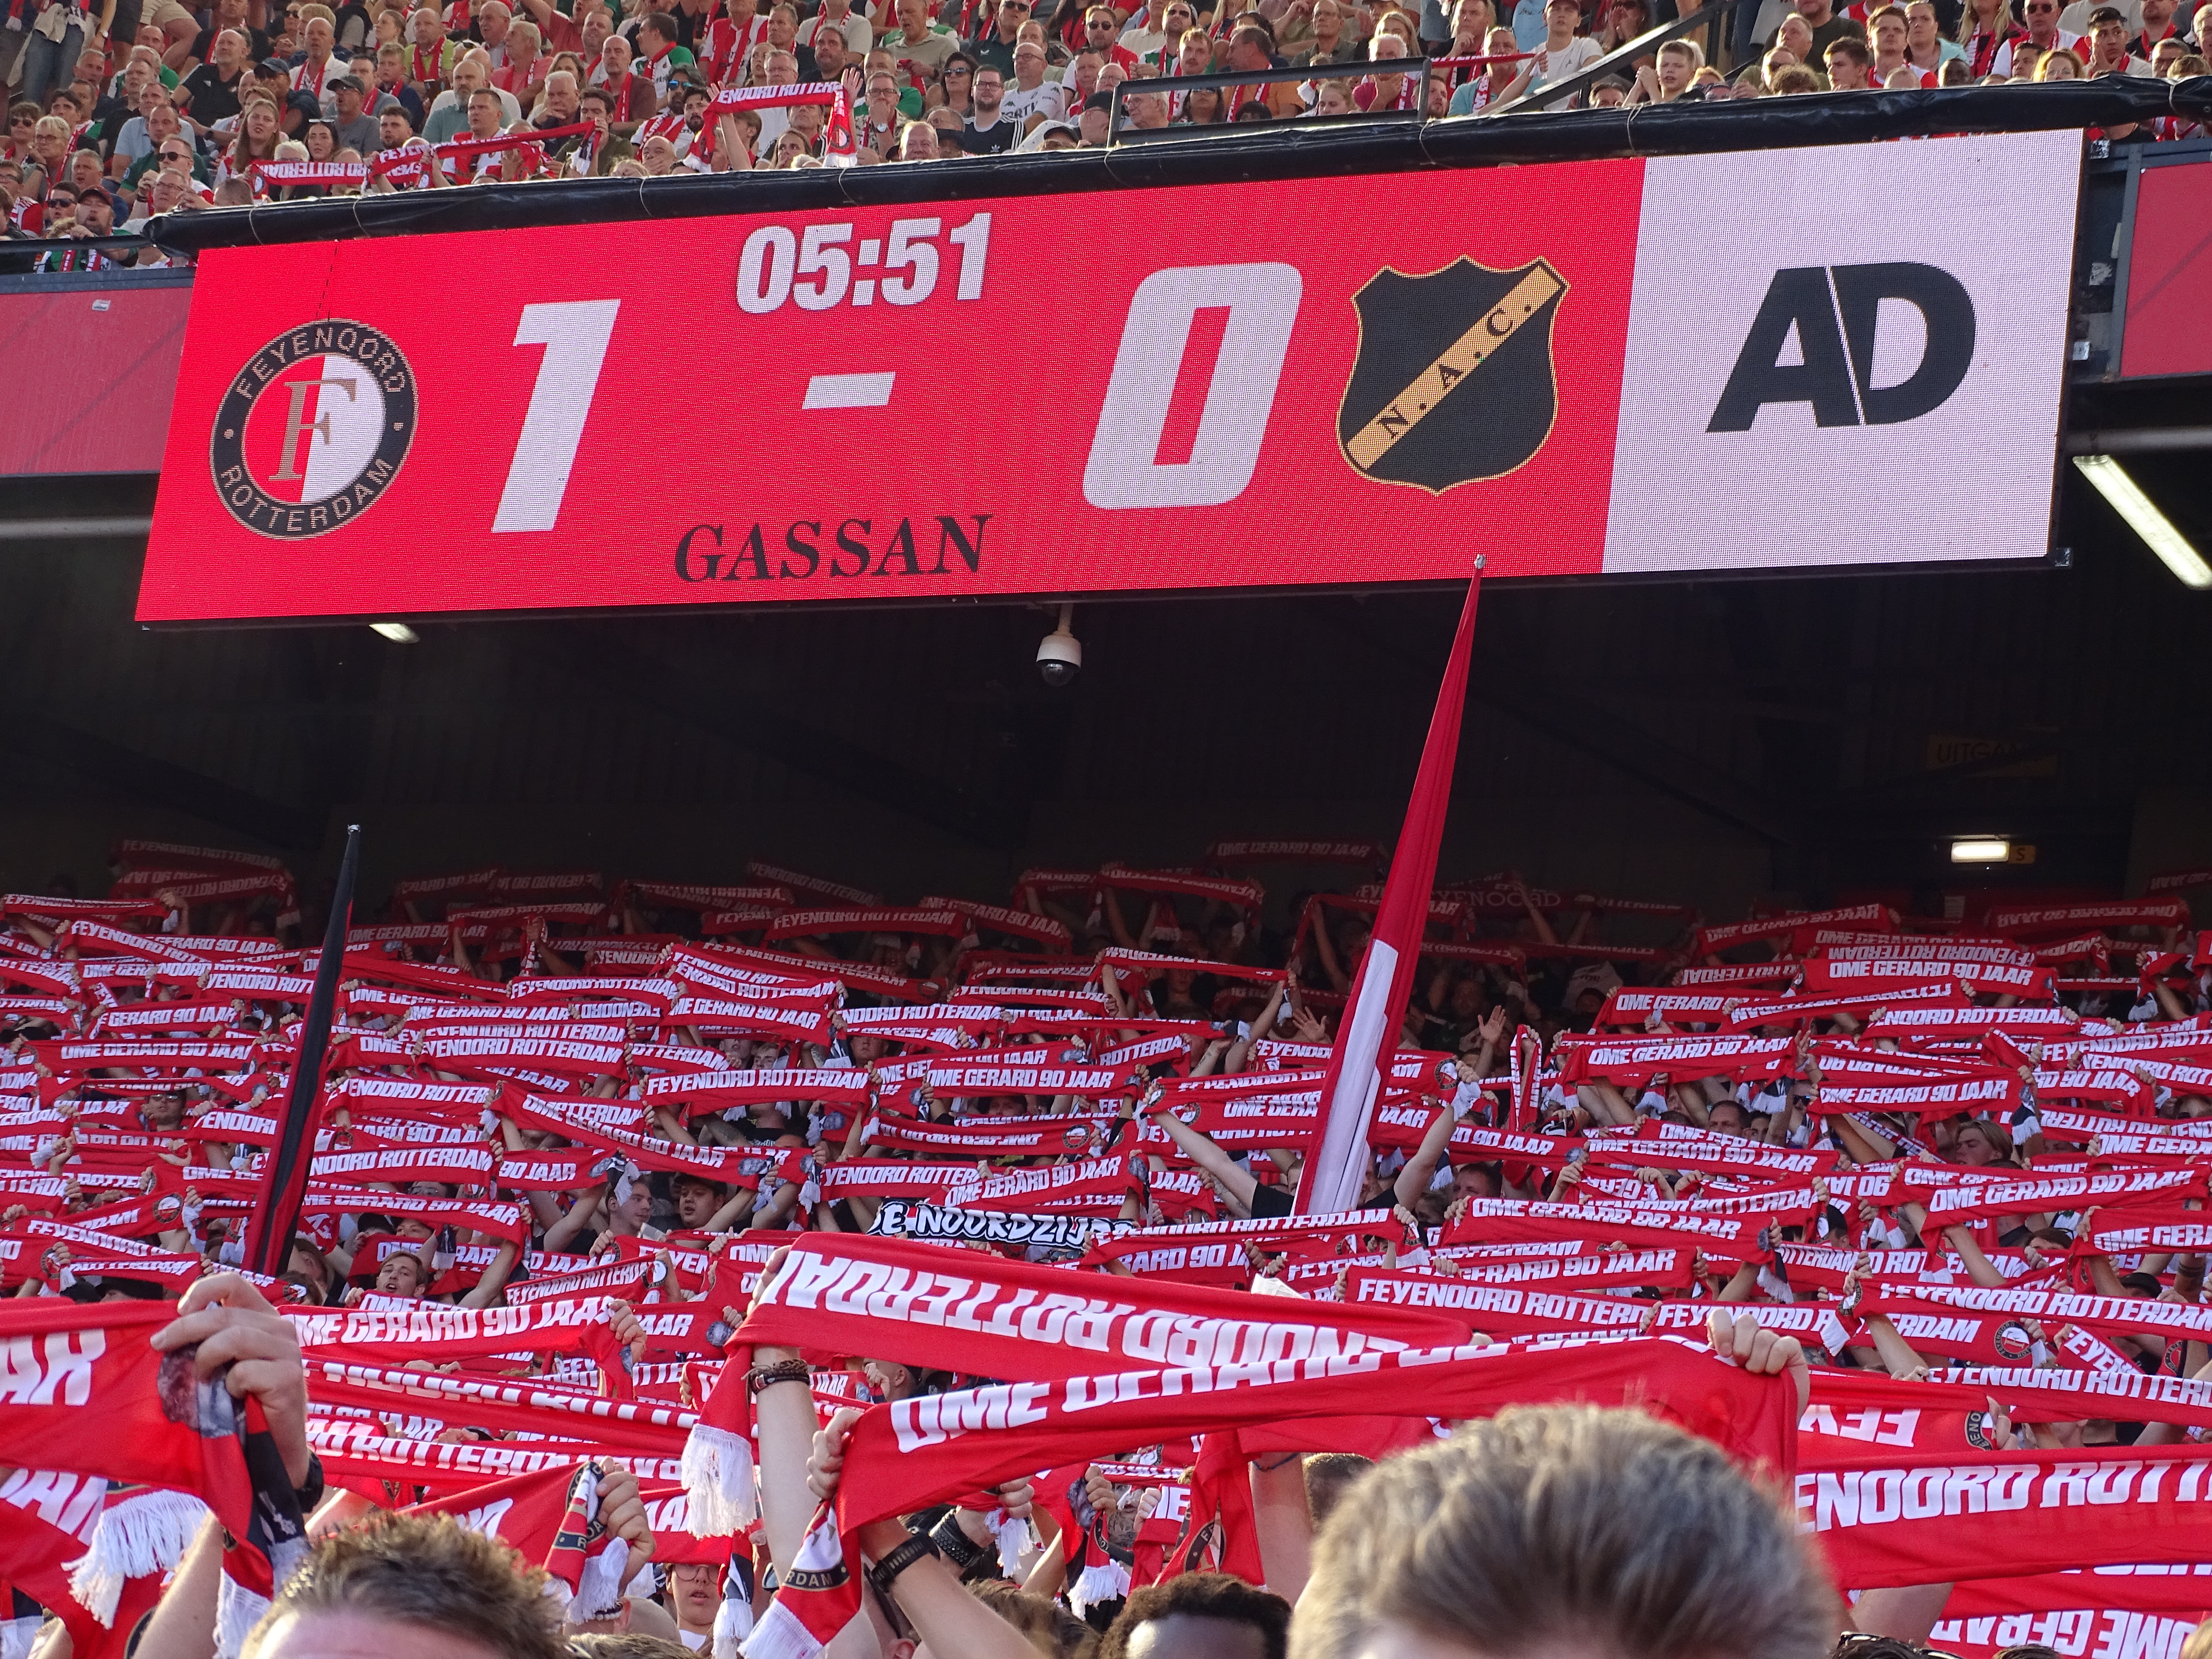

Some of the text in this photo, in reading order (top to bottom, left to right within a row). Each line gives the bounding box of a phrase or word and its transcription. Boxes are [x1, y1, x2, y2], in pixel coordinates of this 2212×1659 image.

[735, 212, 991, 314] 05:51
[1706, 261, 1976, 433] AD
[236, 327, 405, 399] FEYENOORD
[491, 299, 621, 533] 1
[1082, 262, 1303, 509] 0
[268, 378, 357, 481] F
[220, 458, 393, 532] ROTTERDAM
[675, 513, 993, 582] GASSAN
[2016, 847, 2025, 861] S
[71, 921, 163, 956] FEYENOORD
[212, 939, 237, 953] 90
[1829, 962, 2033, 986] OME GERARD 90 JAAR
[439, 1005, 499, 1020] GERARD
[502, 1006, 523, 1019] 90
[526, 1007, 571, 1021] JAAR
[693, 998, 755, 1018] GERARD
[757, 1006, 775, 1020] 90
[776, 1008, 821, 1030] JAAR
[1616, 994, 1651, 1011] OME
[109, 1011, 169, 1026] GERARD
[172, 1009, 194, 1024] 90
[61, 1043, 102, 1059] OME
[360, 1036, 402, 1055] OME
[509, 1038, 623, 1063] ROTTERDAM
[1589, 1048, 1631, 1065] OME
[1633, 1042, 1709, 1063] GERARD
[1711, 1040, 1739, 1056] 90
[336, 1080, 424, 1099] YENOORD
[647, 1068, 869, 1094] FEYENOORD ROTTERDAM
[926, 1069, 1115, 1089] OME GERARD 90 JAAR
[1819, 1080, 2006, 1104] OME GERARD 90 JAAR
[2060, 1071, 2087, 1088] 90
[312, 1149, 492, 1174] NOORD ROTTERDAM
[642, 1136, 669, 1155] 90
[672, 1143, 725, 1168] JAAR
[1723, 1146, 1754, 1164] 90
[1756, 1152, 1817, 1172] JAAR
[499, 1161, 576, 1182] 90 JAAR
[984, 1171, 1049, 1197] GERARD
[1052, 1170, 1074, 1187] 90
[1077, 1152, 1121, 1180] JAAR
[1930, 1186, 1982, 1212] OME
[1985, 1178, 2087, 1205] GERARD
[2089, 1174, 2125, 1193] 90
[28, 1219, 148, 1256] FEYENOORD
[1561, 1249, 1676, 1277] 90 JAAR
[1358, 1278, 1523, 1313] FEYENOORD
[288, 1314, 341, 1348] ME
[341, 1312, 477, 1342] GERARD
[484, 1307, 530, 1338] 90
[1930, 1367, 2081, 1391] EYENOORD
